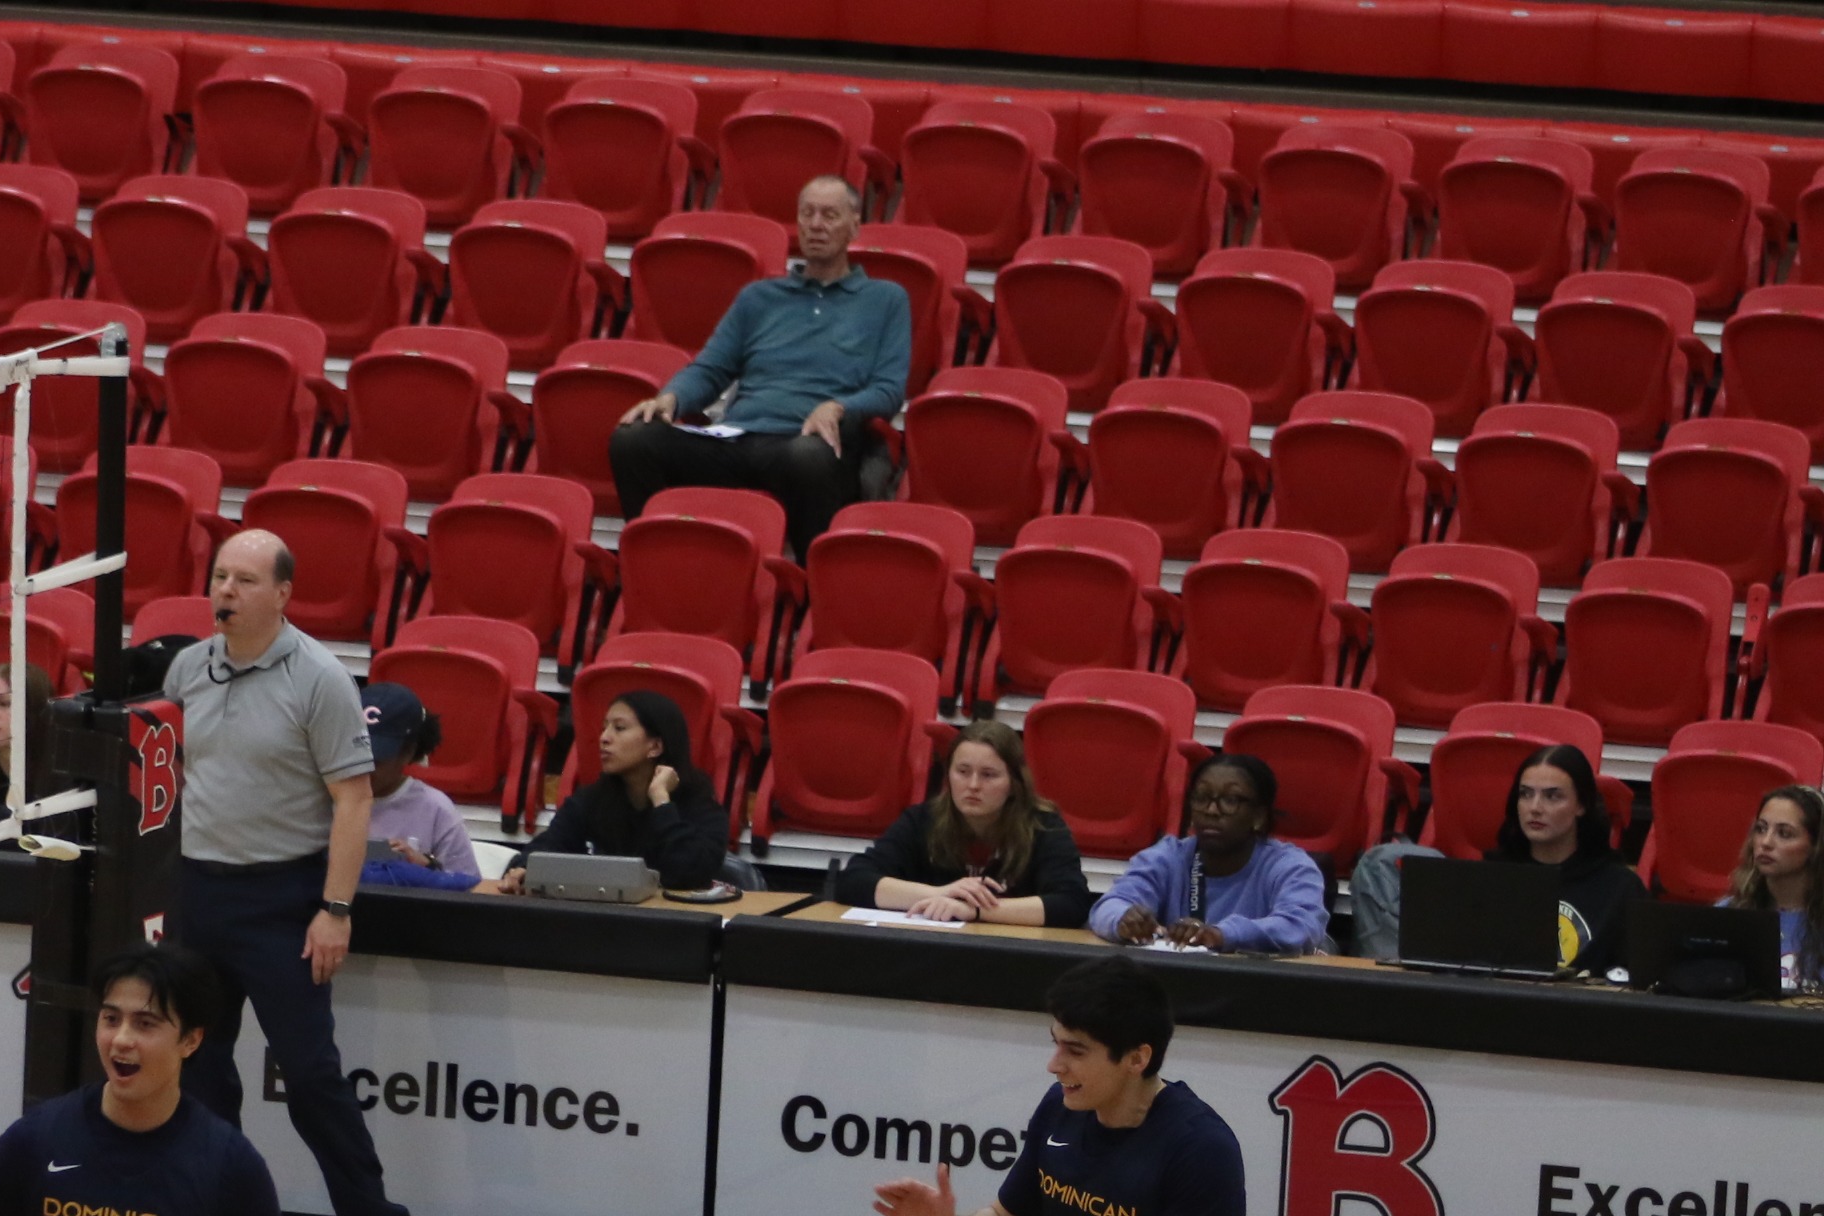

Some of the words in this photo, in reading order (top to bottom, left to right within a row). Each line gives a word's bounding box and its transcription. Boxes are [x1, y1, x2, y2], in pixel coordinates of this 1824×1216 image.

[138, 722, 176, 836] B
[262, 1046, 640, 1138] Ecellence.
[781, 1094, 1029, 1176] Compe
